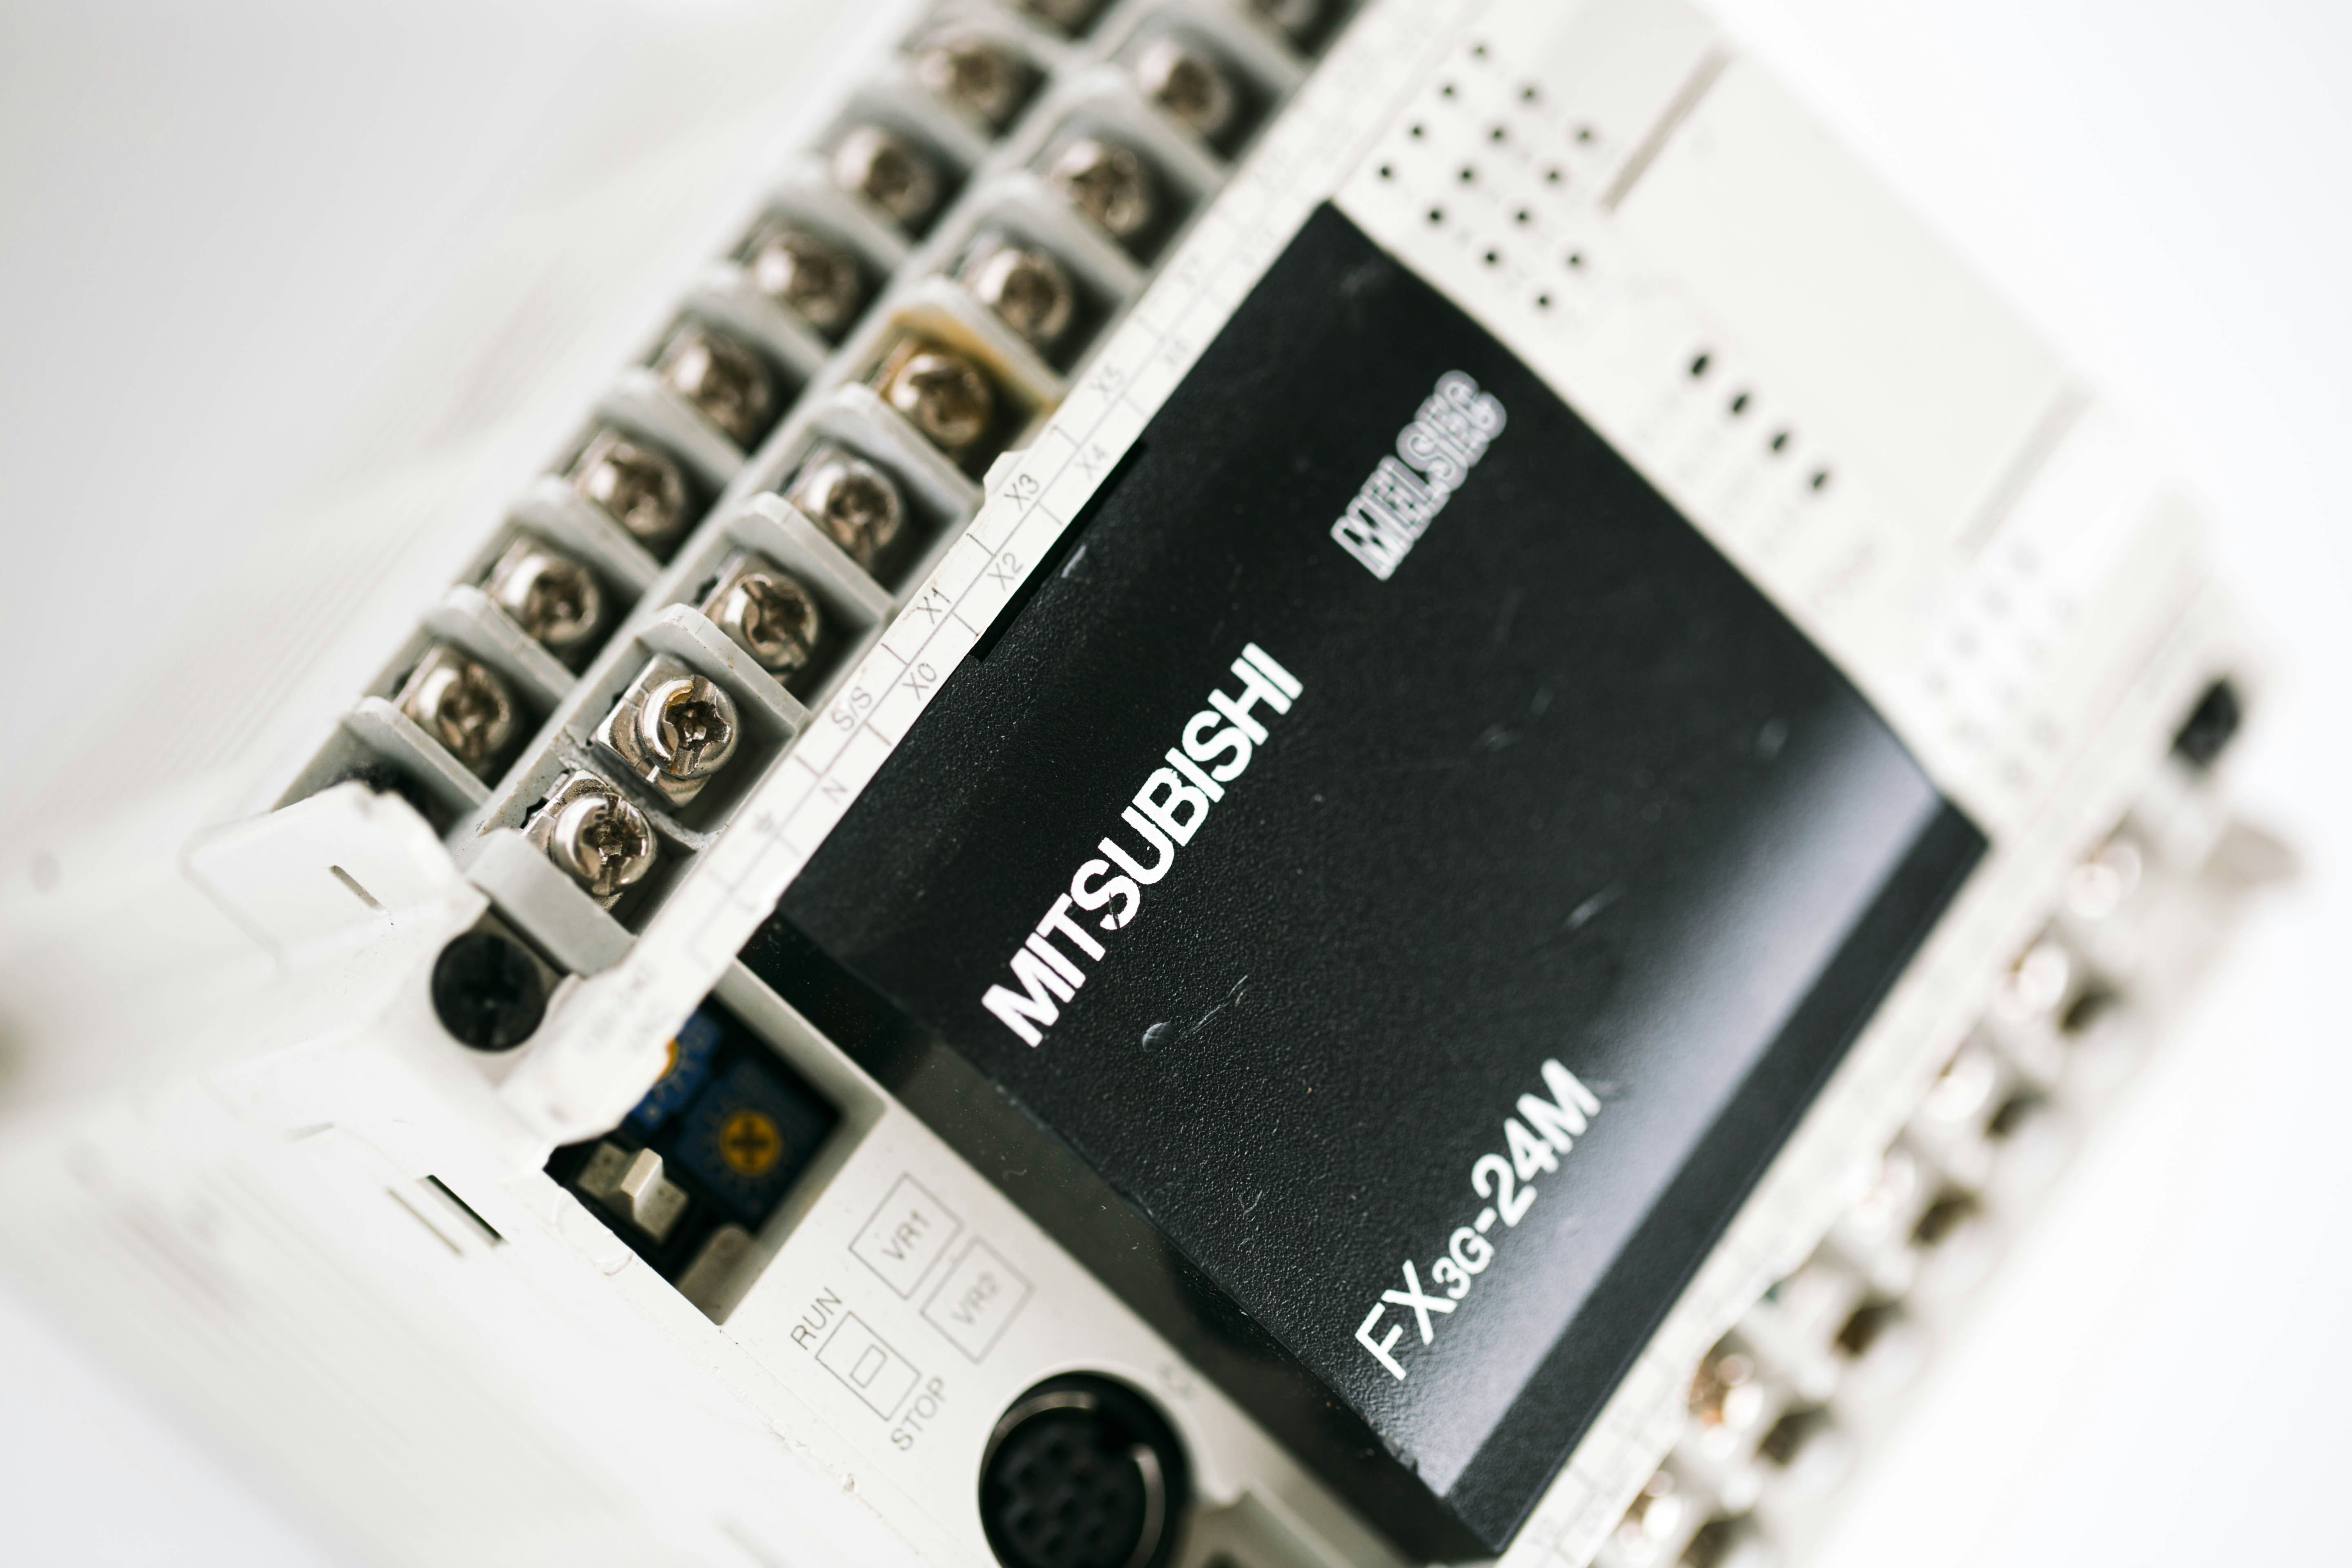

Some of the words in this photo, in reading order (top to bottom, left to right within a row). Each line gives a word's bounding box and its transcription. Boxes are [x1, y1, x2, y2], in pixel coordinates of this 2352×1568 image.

[1003, 474, 1040, 512] X3
[1330, 370, 1507, 581] MELSEC
[987, 552, 1024, 591] X2
[917, 587, 951, 625] X1
[831, 686, 872, 731] S/S
[902, 662, 937, 701] X0
[822, 777, 848, 804] N
[982, 642, 1303, 1048] MITSUBISHI
[881, 1208, 933, 1263] VR1
[1354, 1058, 1601, 1381] FX3G-24M
[790, 1286, 844, 1350] RUN
[950, 1271, 1002, 1326] VR2
[890, 1377, 947, 1451] STOP
